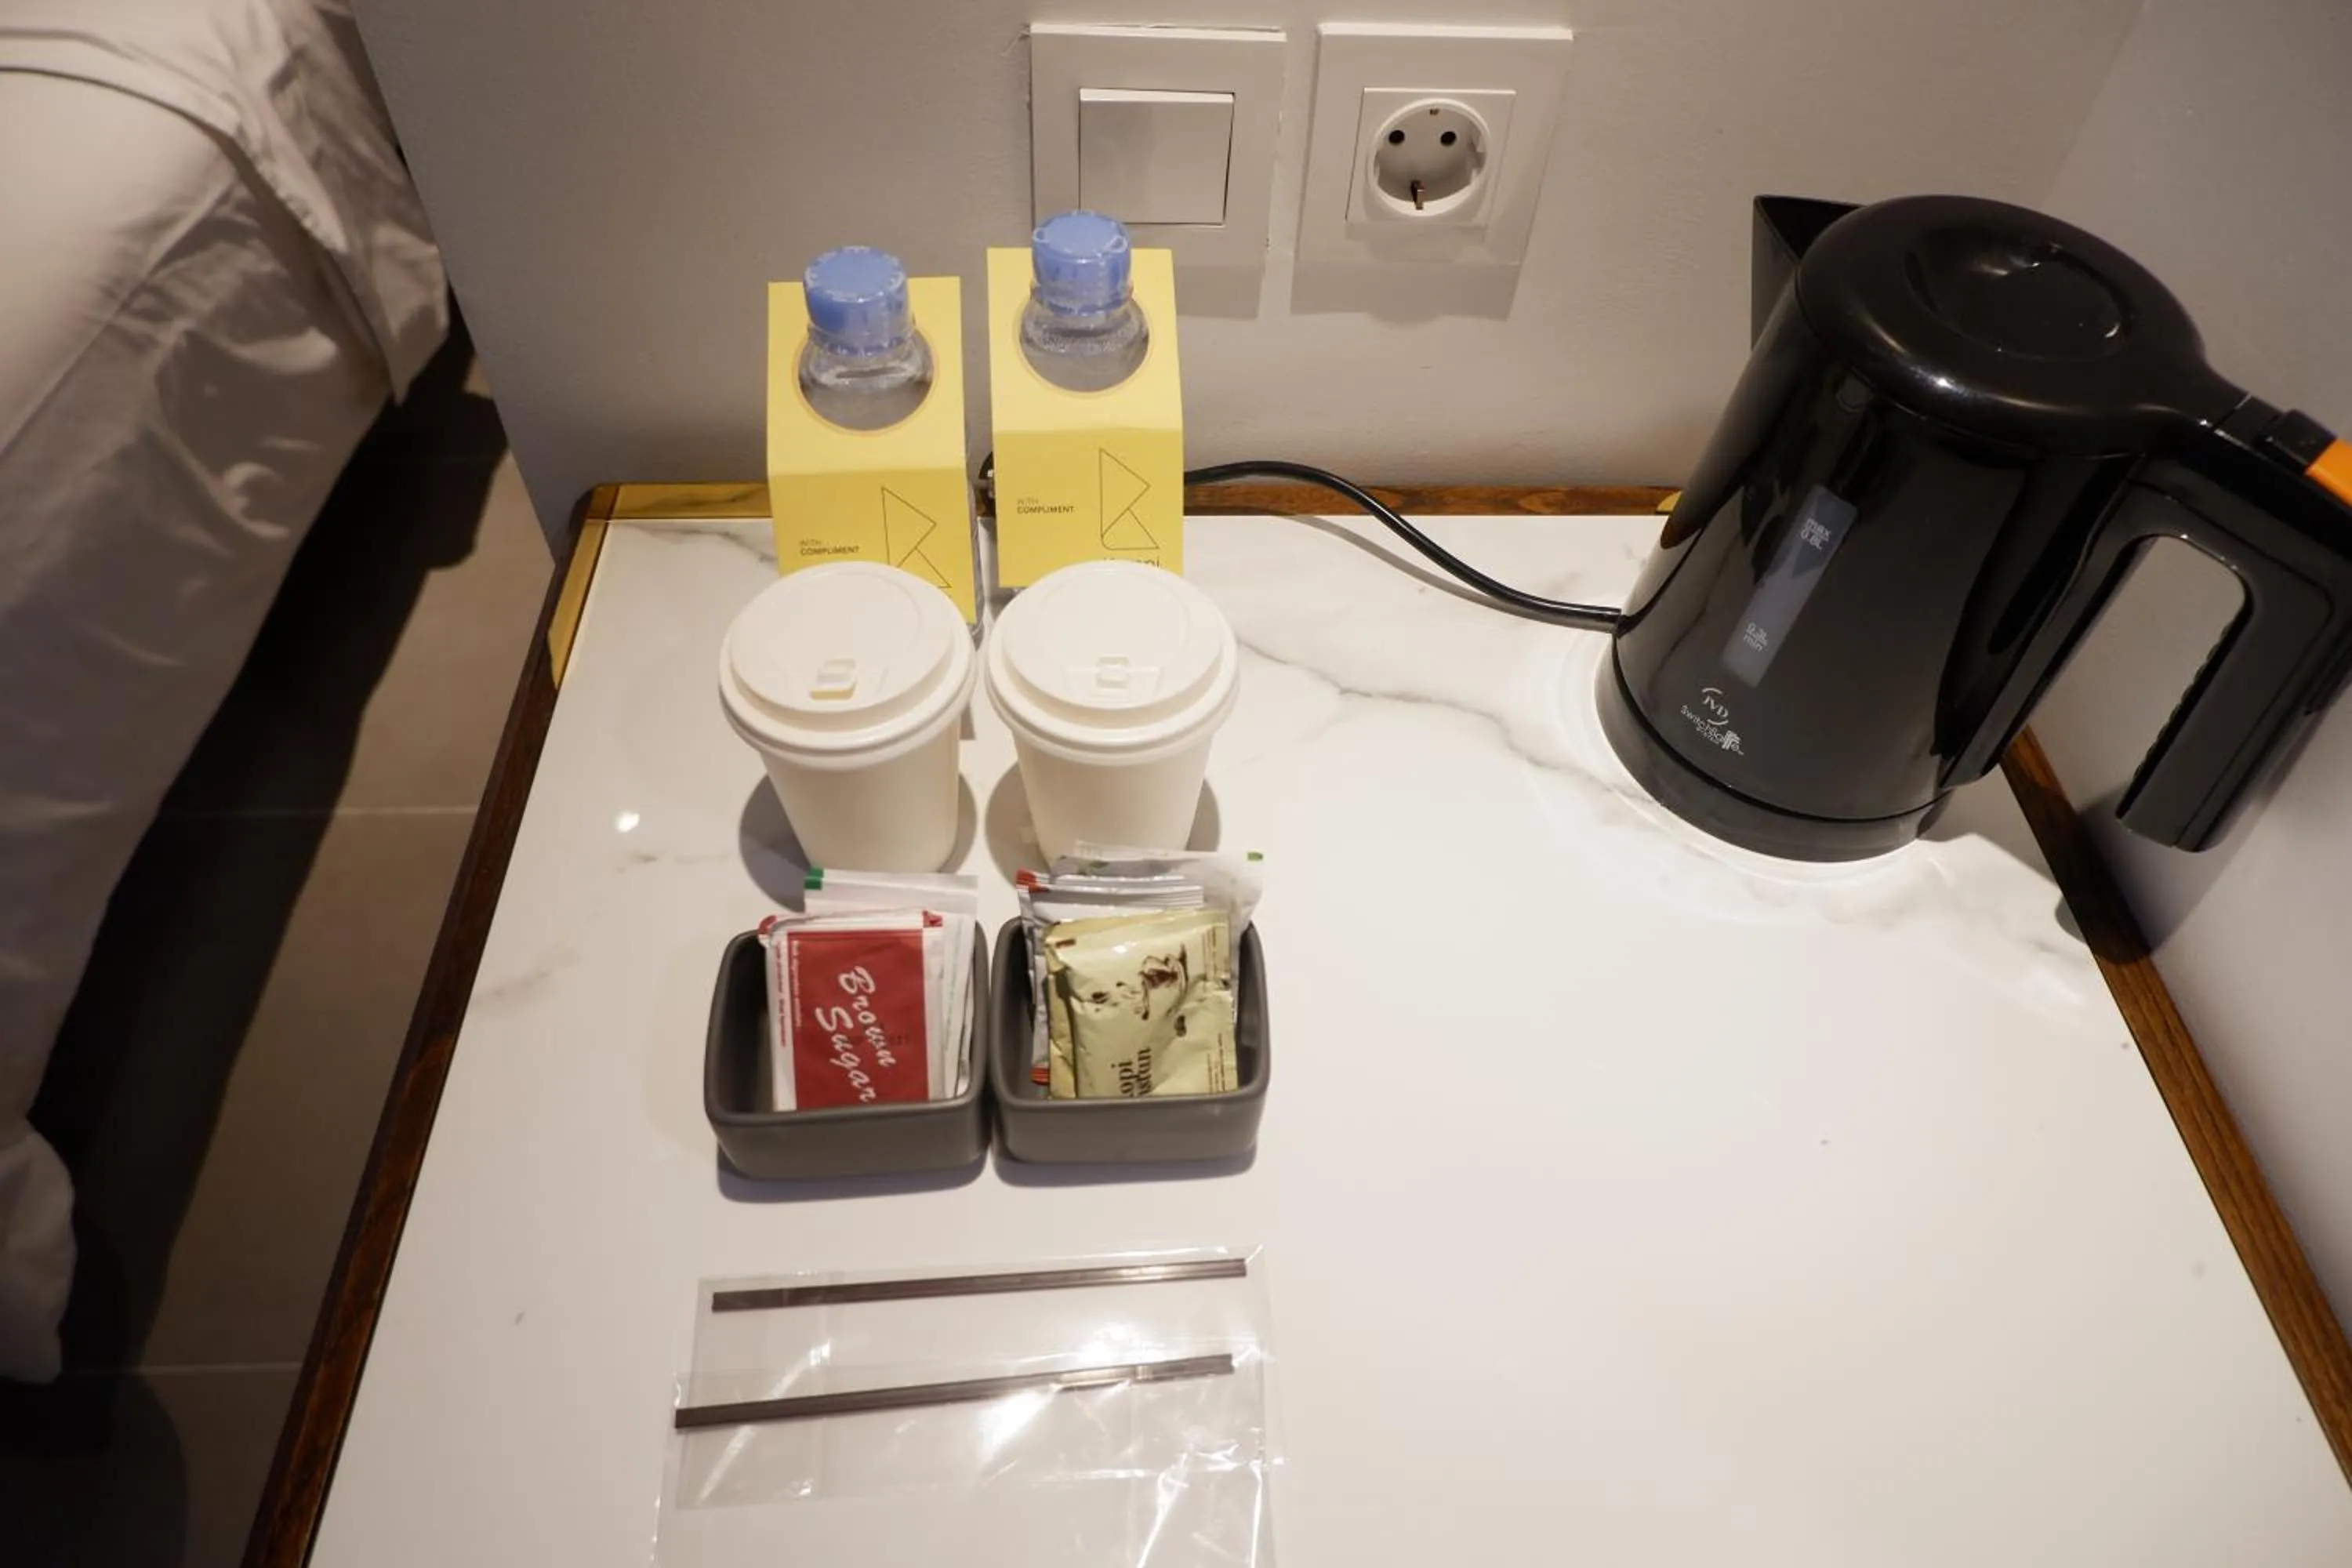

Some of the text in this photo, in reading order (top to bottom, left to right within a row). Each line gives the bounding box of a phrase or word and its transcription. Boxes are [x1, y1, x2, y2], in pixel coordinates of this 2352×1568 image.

[1016, 505, 1075, 514] COMPLIMENT
[1804, 517, 1831, 538] max
[800, 546, 859, 556] COMPLIMENT
[837, 965, 896, 1068] Brown
[814, 1007, 877, 1103] Sugar
[1111, 1060, 1139, 1098] opi
